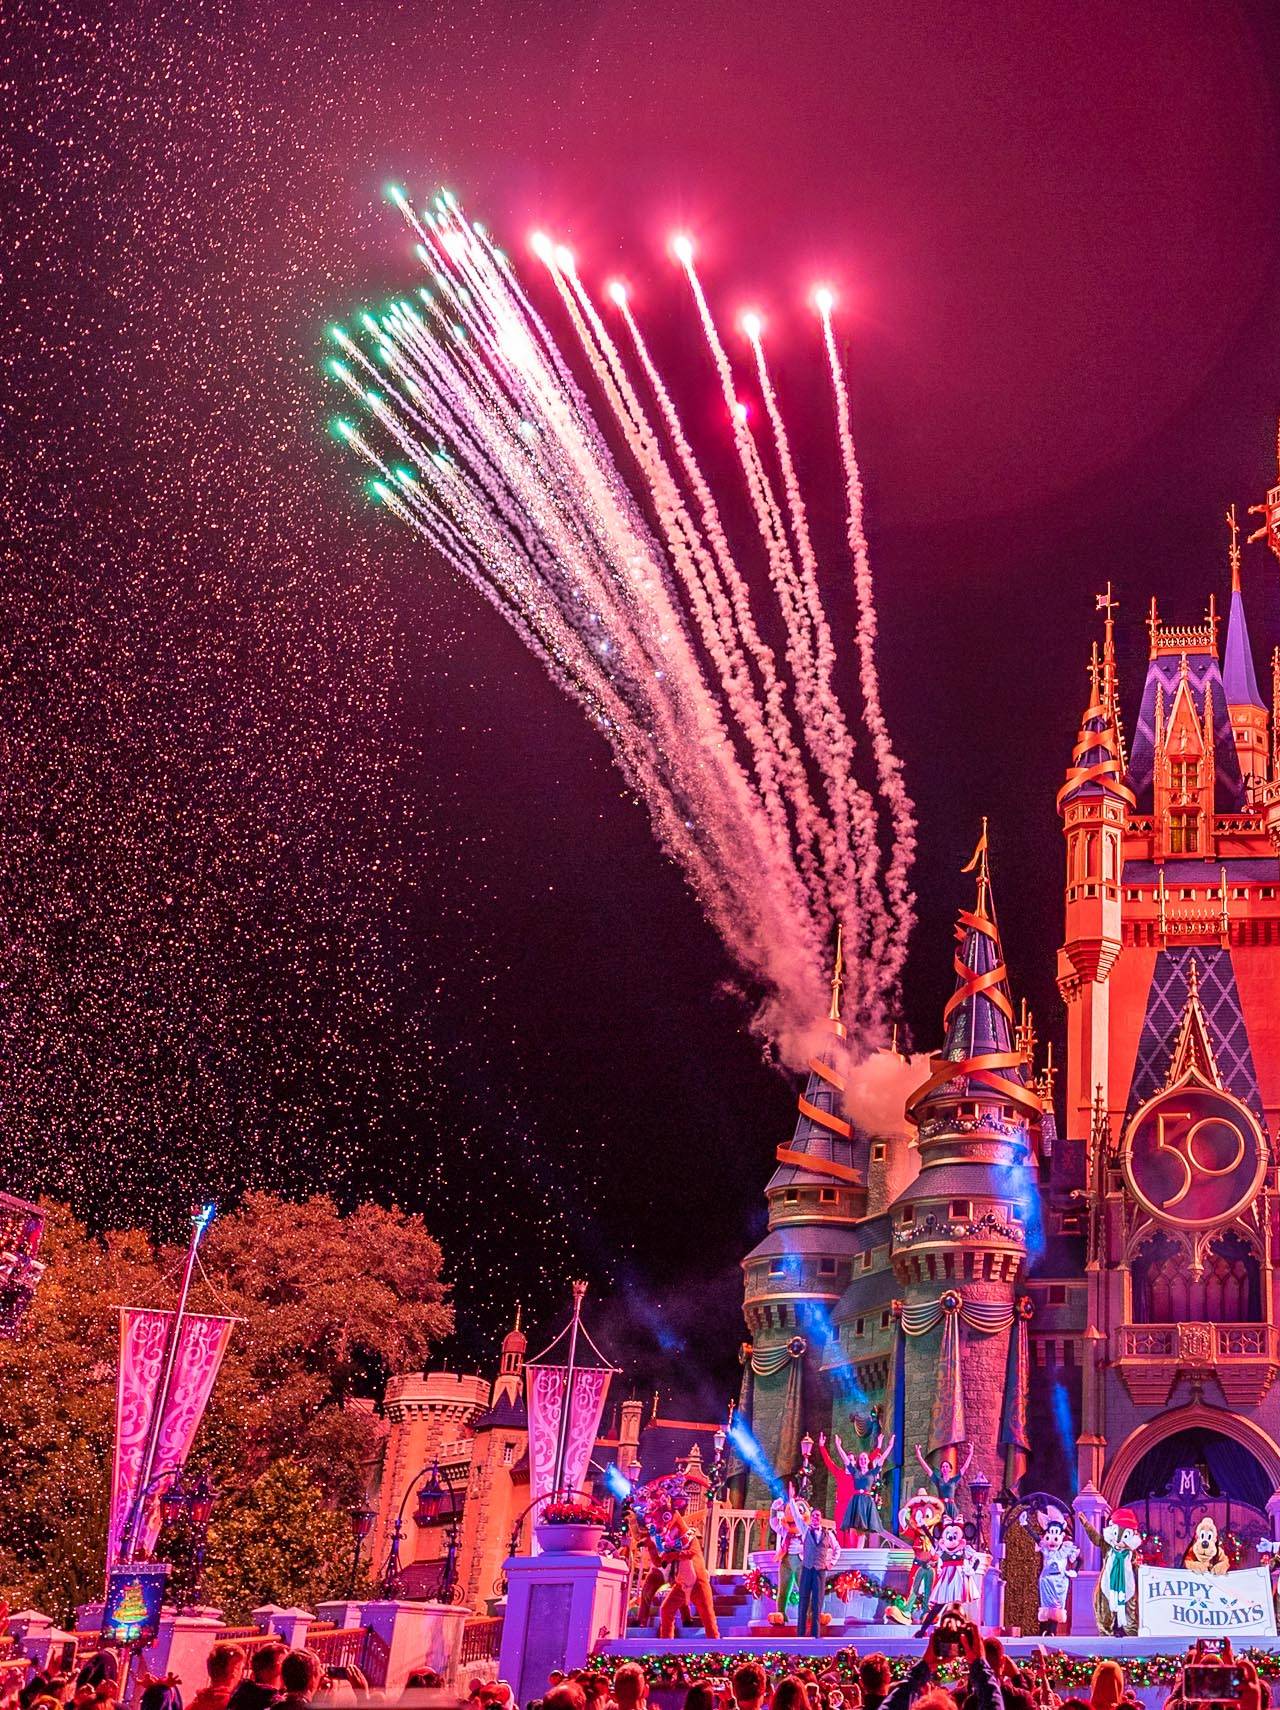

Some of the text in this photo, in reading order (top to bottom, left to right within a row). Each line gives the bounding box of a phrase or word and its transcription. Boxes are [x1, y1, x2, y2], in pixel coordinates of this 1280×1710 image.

[1158, 1112, 1245, 1209] 50
[1148, 1580, 1214, 1600] HAPPY
[1172, 1604, 1264, 1626] HOLIDAYS
